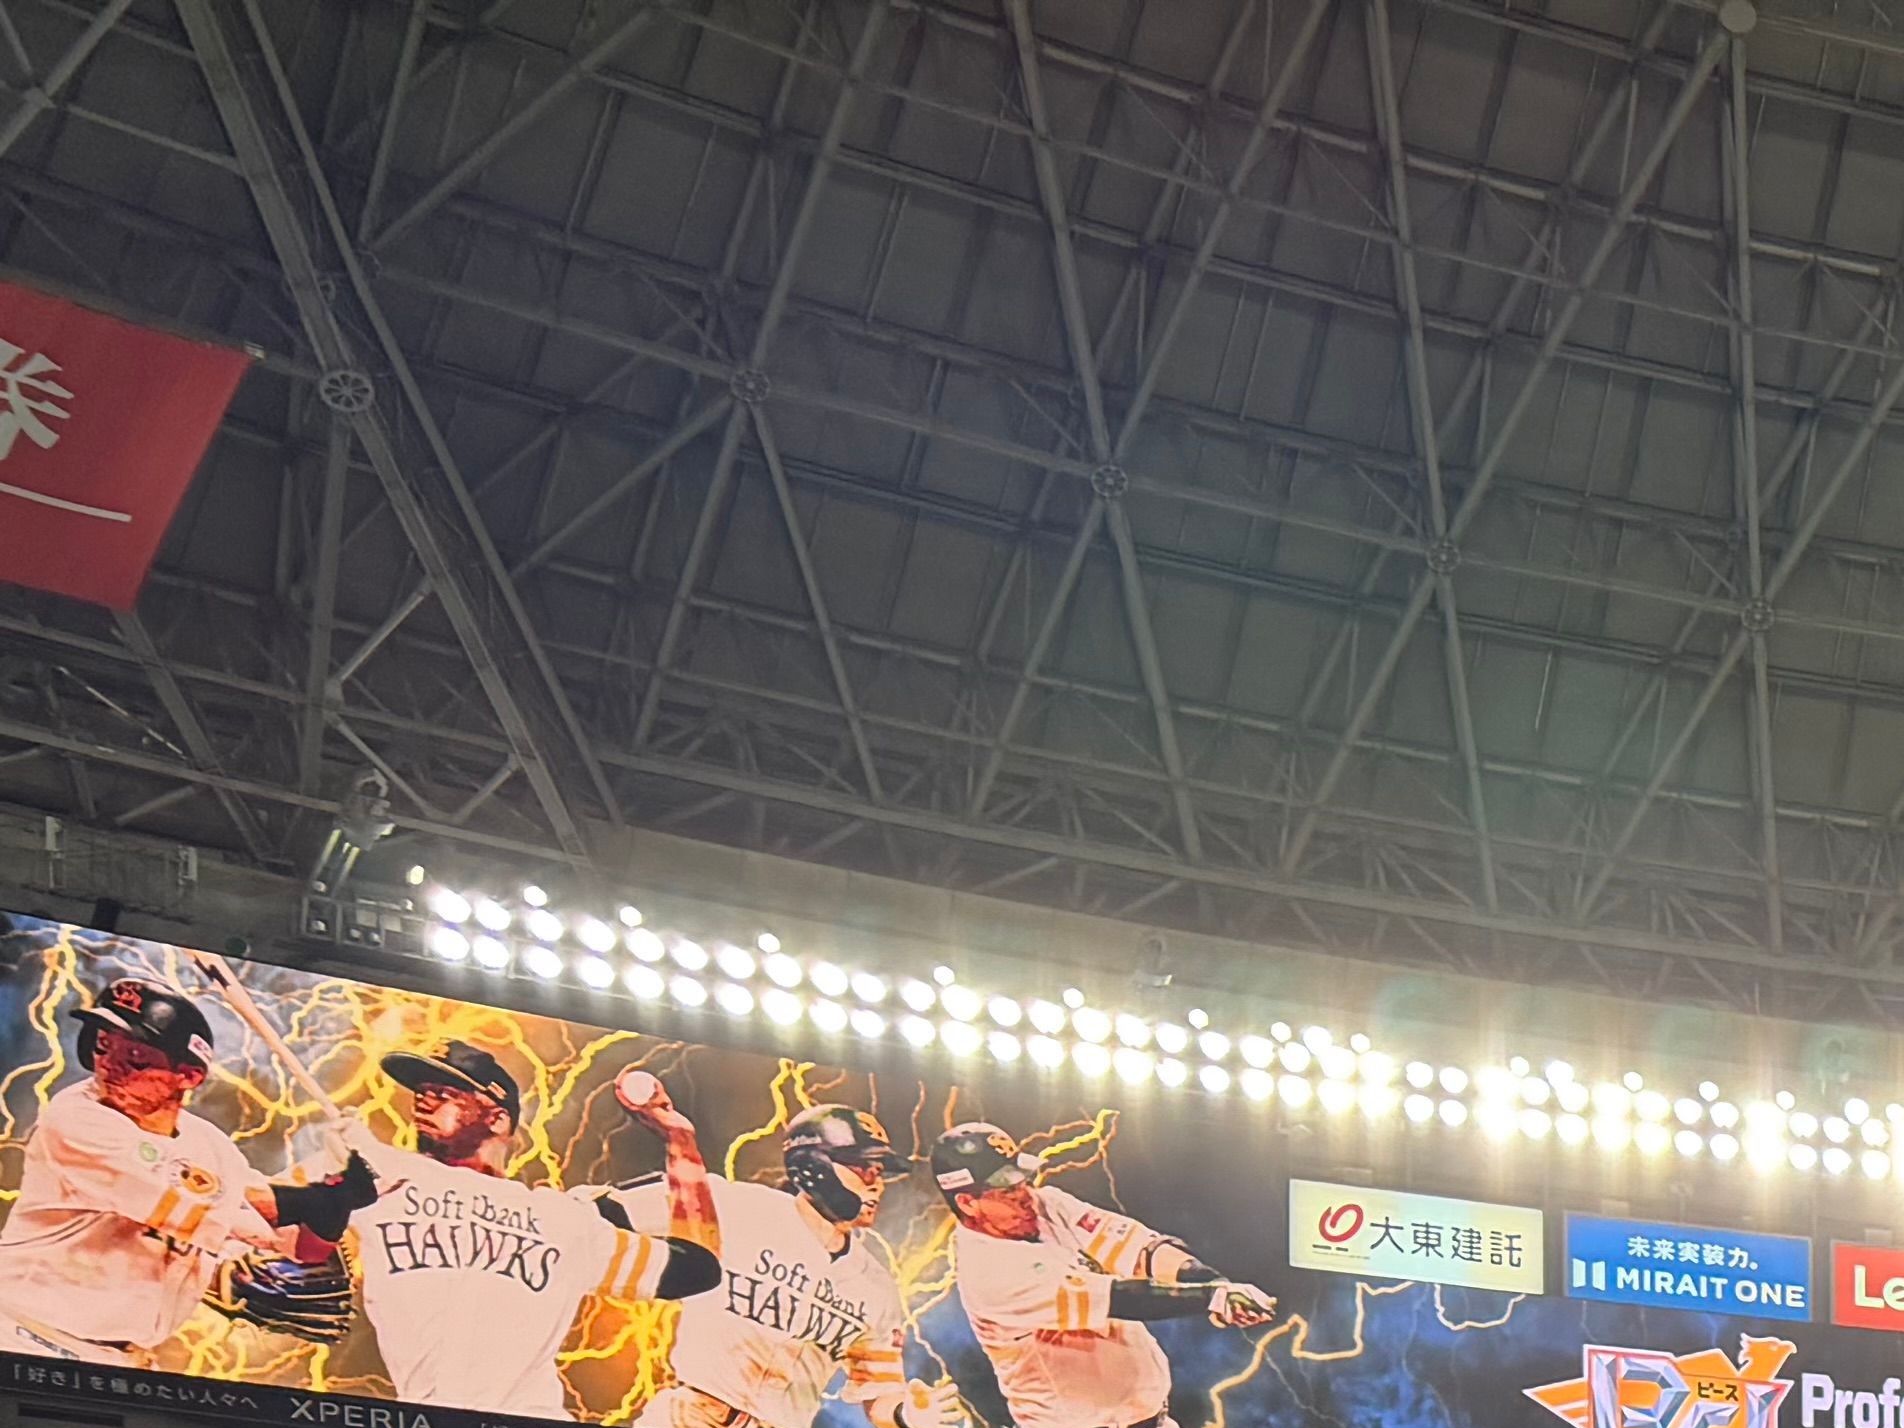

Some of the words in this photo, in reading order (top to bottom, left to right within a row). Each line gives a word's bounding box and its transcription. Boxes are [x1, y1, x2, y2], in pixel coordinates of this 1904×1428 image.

[1368, 1215, 1524, 1269] 大東建託
[1627, 1235, 1759, 1271] 未来実装力。
[1616, 1266, 1730, 1300] MIRAIT
[1735, 1278, 1806, 1309] ONE
[1697, 1381, 1740, 1402] ピース
